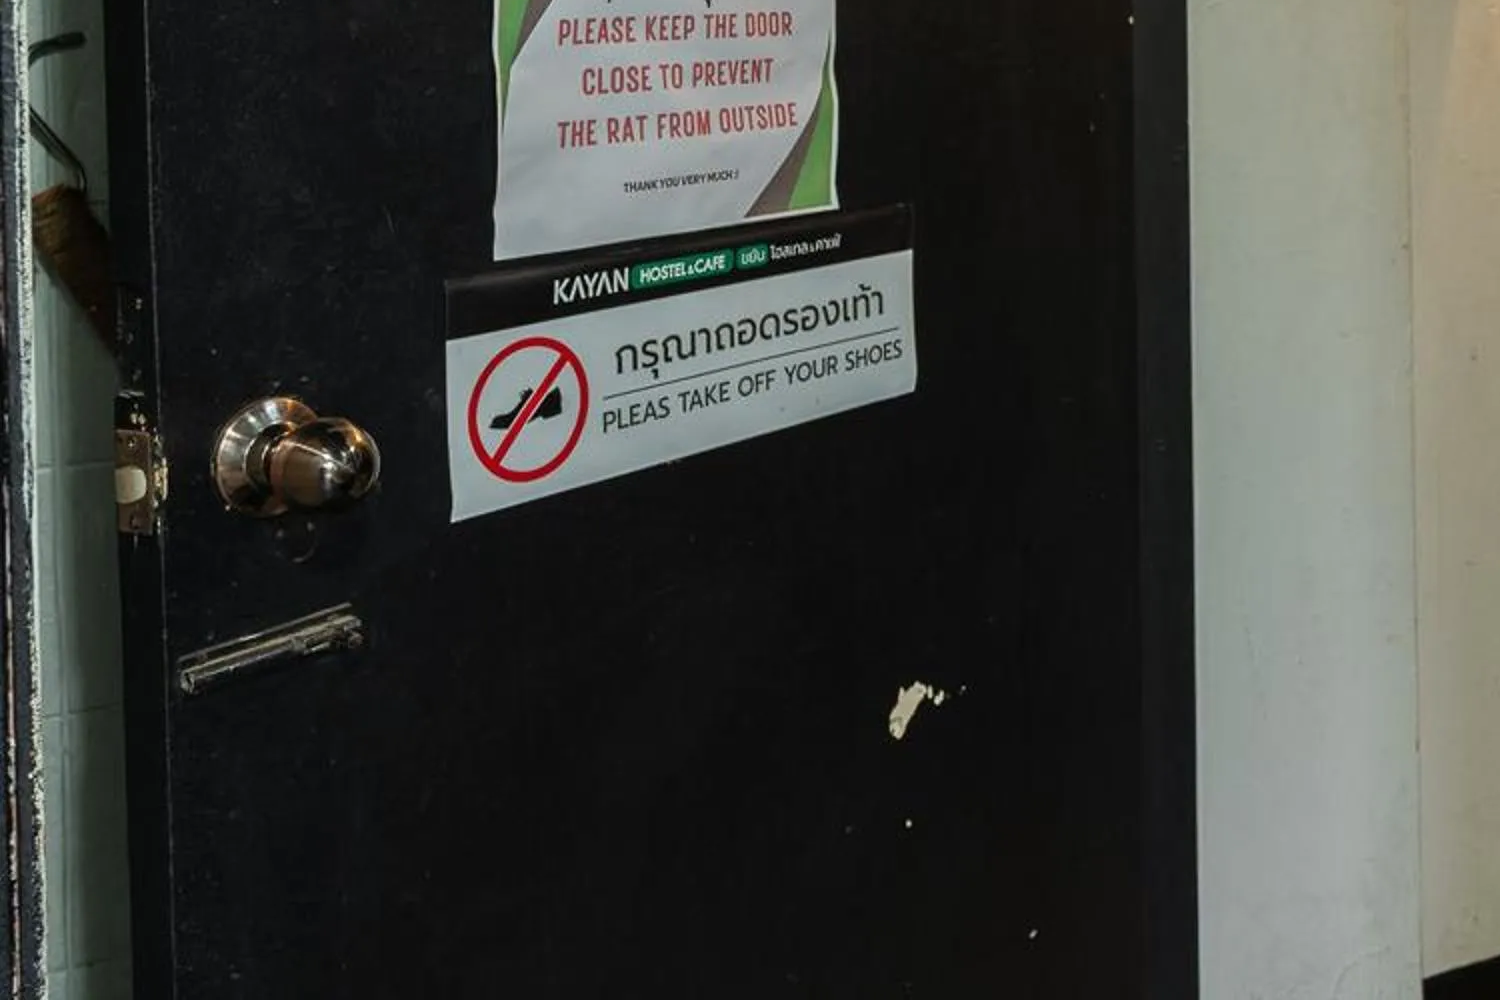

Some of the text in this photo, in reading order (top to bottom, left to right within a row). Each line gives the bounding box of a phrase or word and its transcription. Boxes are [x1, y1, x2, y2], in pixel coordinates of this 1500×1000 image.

[558, 11, 793, 46] PLEASE KEEP THE DOOR
[583, 58, 774, 95] CLOSE TO PREVENT
[557, 102, 798, 149] THE RAT FROM OUTSIDE
[624, 180, 658, 193] THANK
[659, 177, 680, 190] YOU
[681, 173, 706, 186] VERY
[707, 170, 733, 183] MUCH
[553, 255, 726, 306] KAYAN HOSTEL&CAFE
[614, 283, 885, 379] กรุณาถอดรองเท้า
[602, 339, 903, 433] PLEAS TAKE OFF YOUR SHOES
